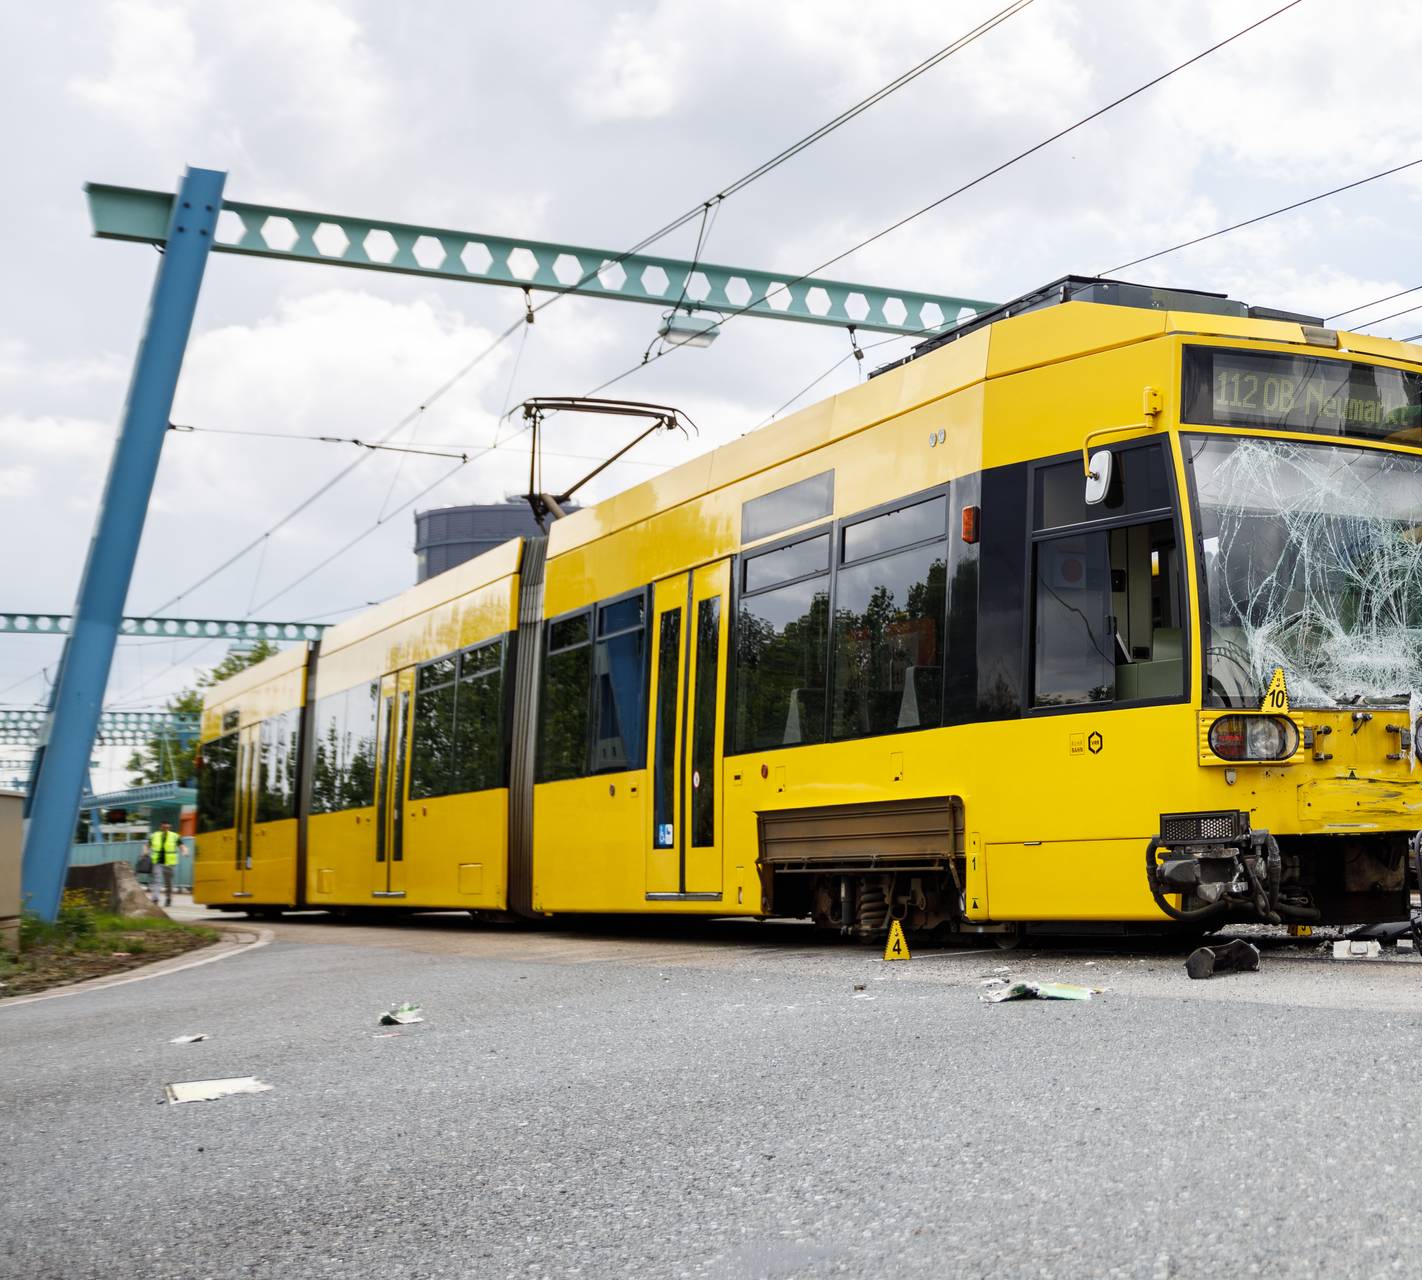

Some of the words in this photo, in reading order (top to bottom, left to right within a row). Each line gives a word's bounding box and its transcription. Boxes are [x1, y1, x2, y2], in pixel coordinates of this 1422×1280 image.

[1216, 372, 1259, 408] 112
[1263, 377, 1295, 412] OB
[1269, 689, 1285, 708] 10
[972, 856, 976, 871] 1
[892, 938, 902, 955] 4
